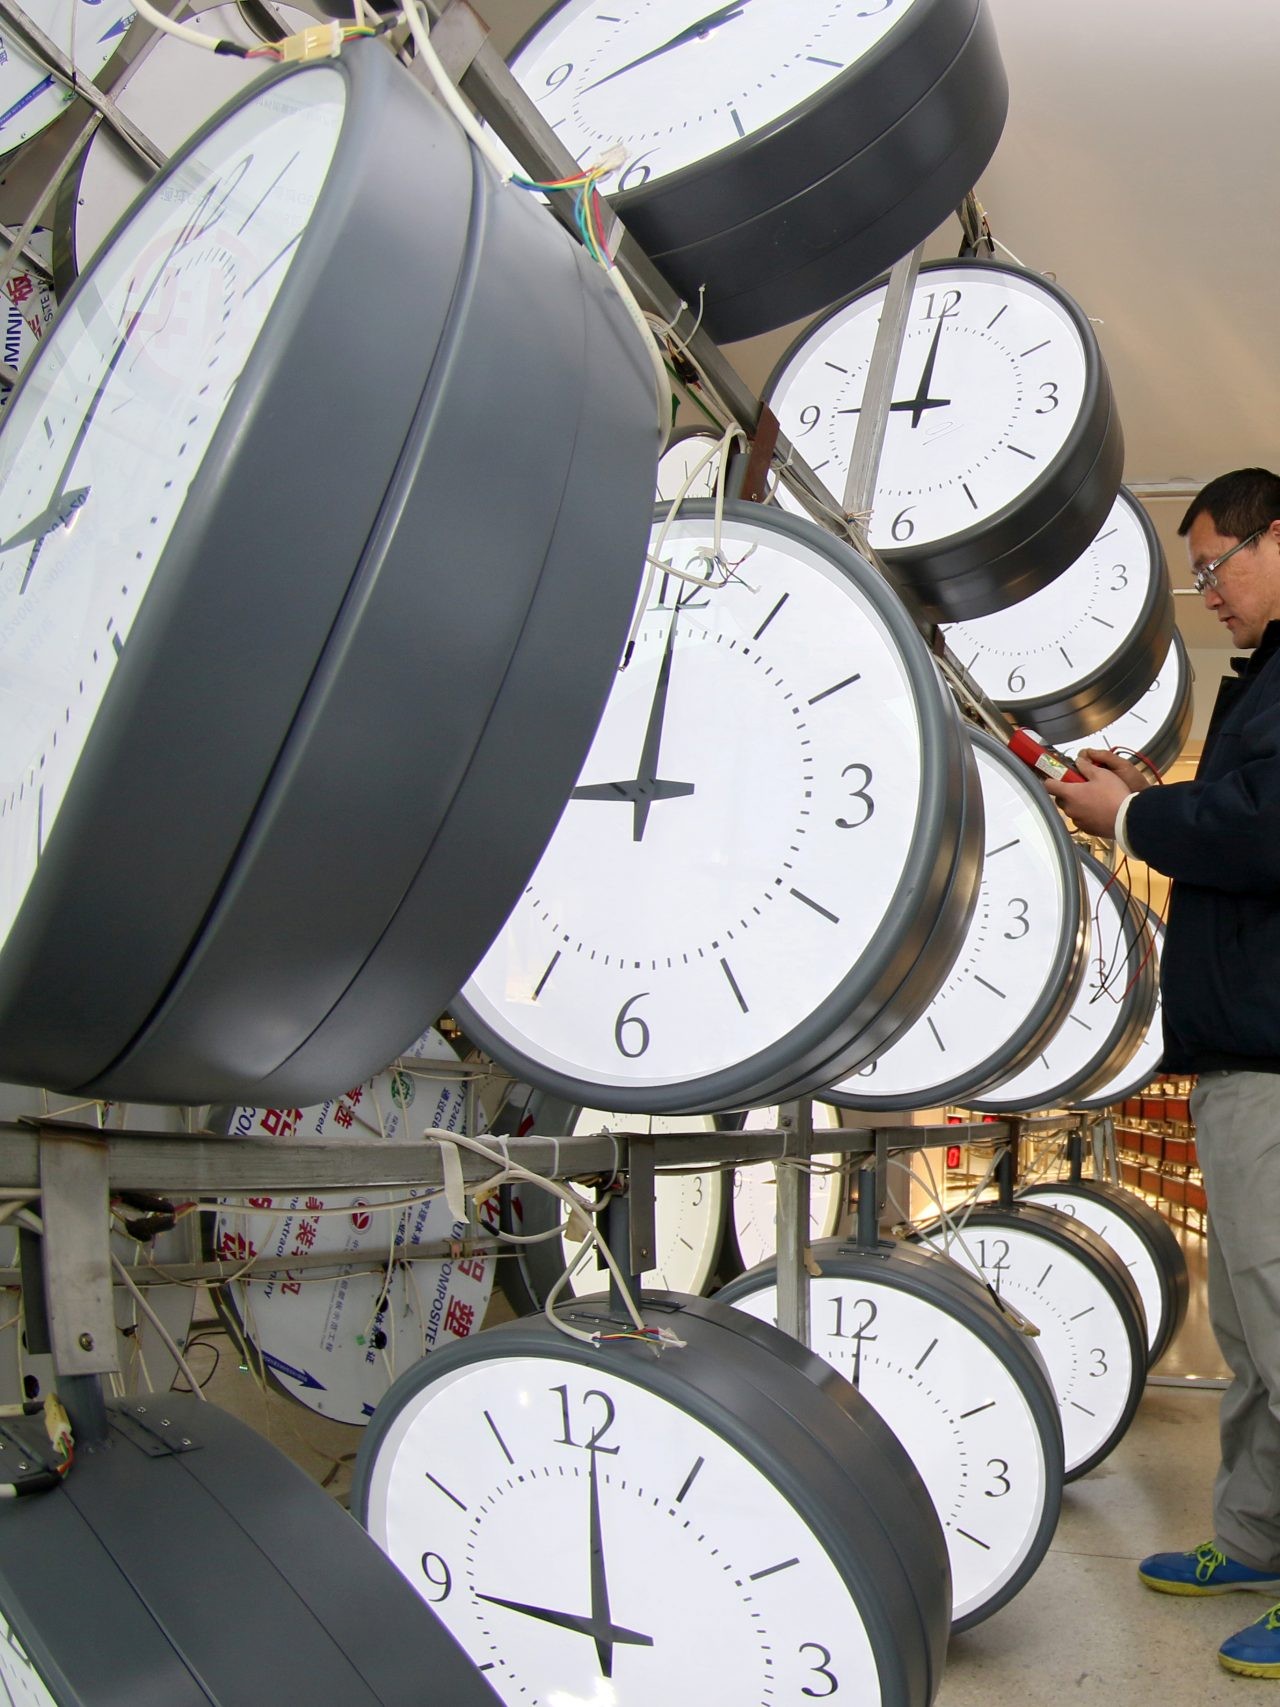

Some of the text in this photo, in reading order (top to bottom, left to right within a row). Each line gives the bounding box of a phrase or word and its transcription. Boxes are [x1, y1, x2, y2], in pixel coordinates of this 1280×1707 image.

[535, 63, 573, 101] 9
[618, 147, 661, 192] 6
[920, 290, 962, 320] 12
[1036, 383, 1060, 414] 3
[798, 405, 821, 437] 9
[891, 506, 915, 542] 6
[647, 555, 714, 612] 12
[1110, 565, 1129, 590] 3
[1007, 664, 1026, 693] 6
[835, 763, 874, 828] 3
[1004, 897, 1030, 939] 3
[1090, 958, 1106, 988] 3
[615, 993, 650, 1058] 6
[692, 1176, 703, 1206] 3
[733, 1170, 743, 1199] 9
[977, 1239, 1011, 1270] 12
[827, 1296, 879, 1342] 12
[1090, 1349, 1108, 1377] 3
[549, 1385, 621, 1455] 12
[984, 1459, 1011, 1497] 3
[421, 1552, 452, 1602] 9
[798, 1642, 838, 1697] 3
